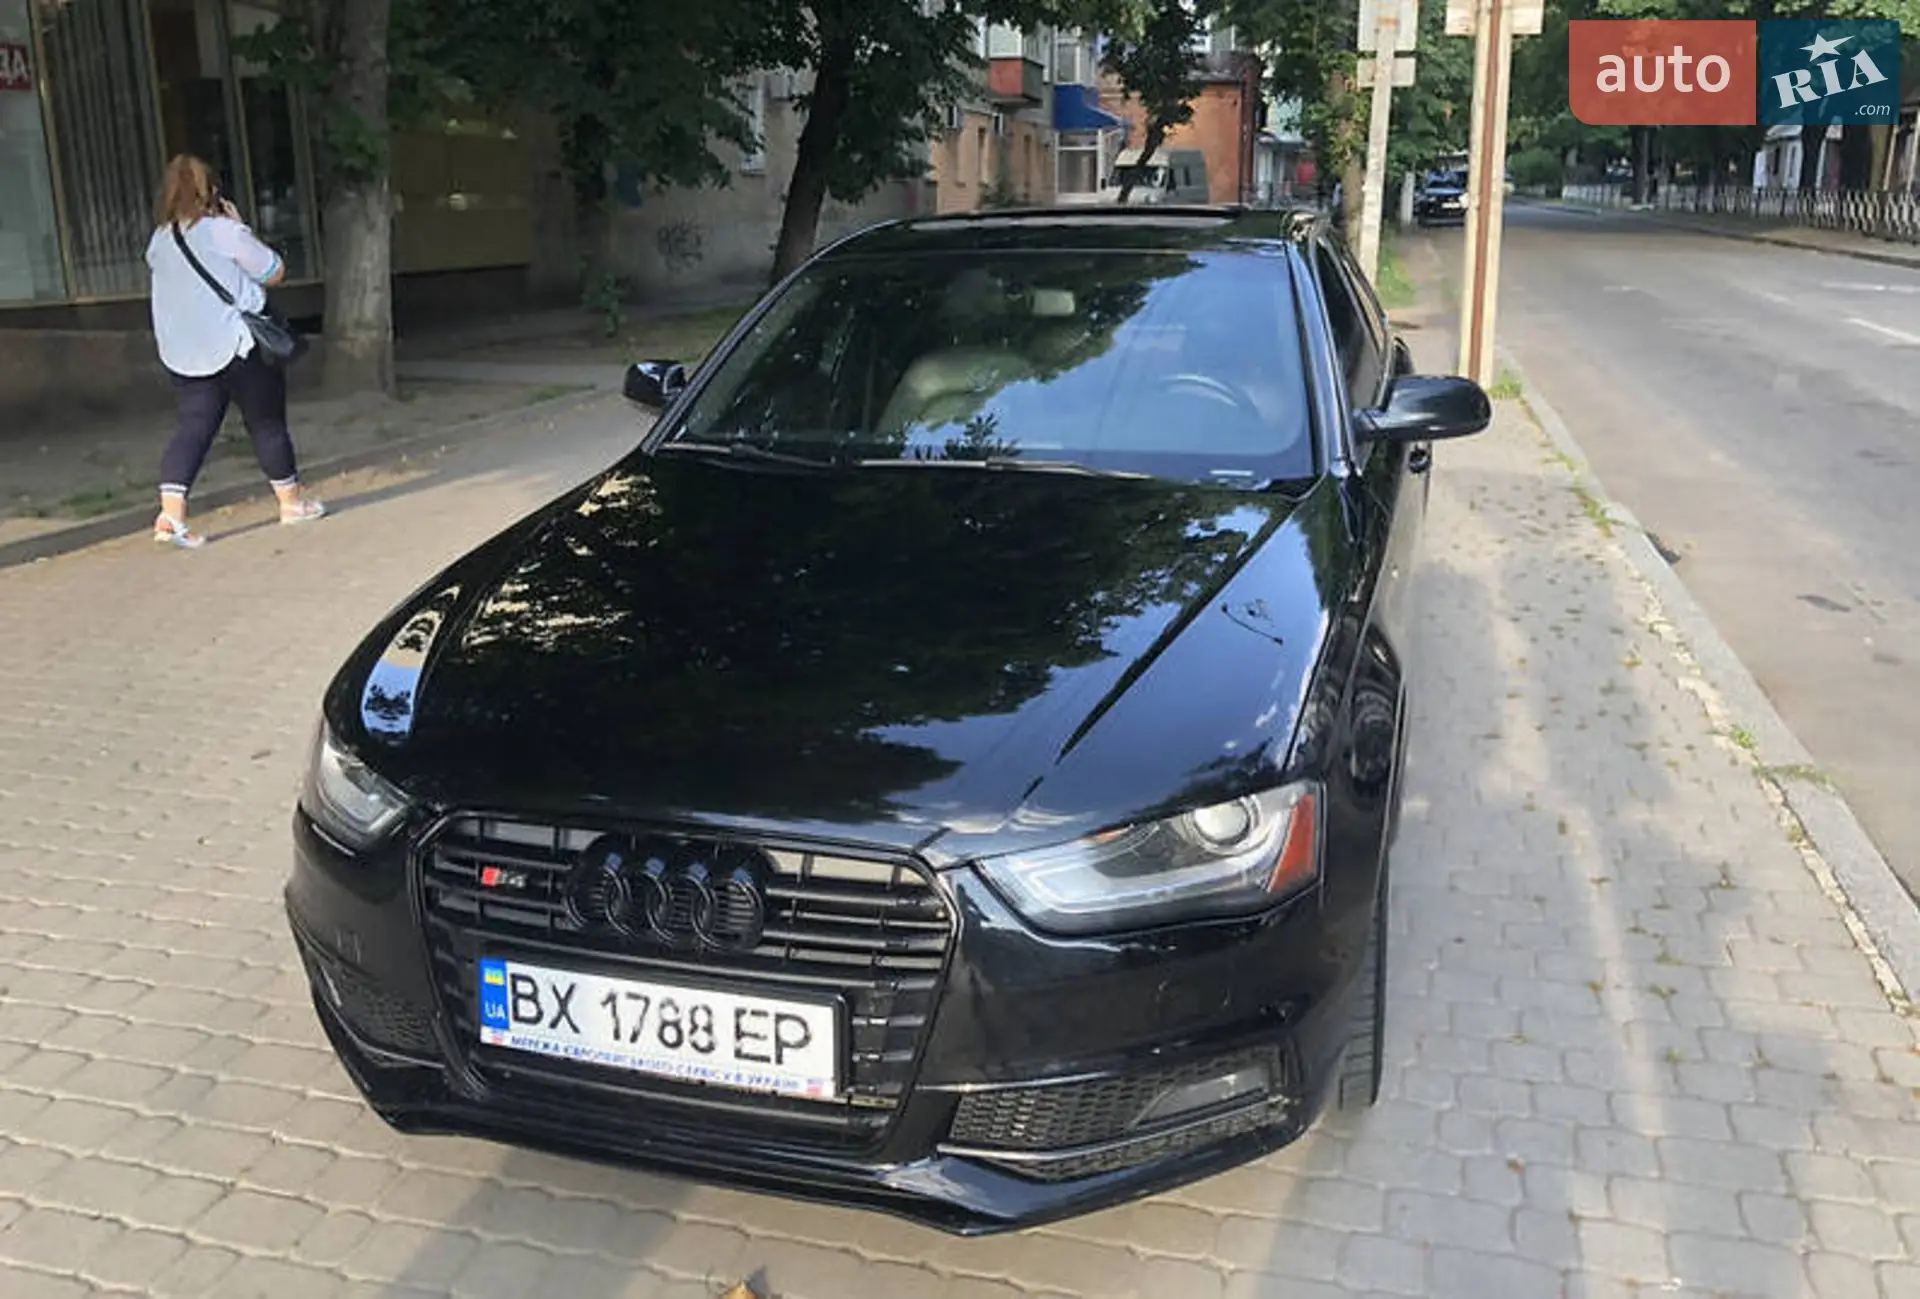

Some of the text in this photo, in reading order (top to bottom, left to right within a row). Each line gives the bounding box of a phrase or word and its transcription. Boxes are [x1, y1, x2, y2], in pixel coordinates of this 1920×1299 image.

[484, 1001, 506, 1019] UA
[510, 973, 812, 1065] BX 1788 EP
